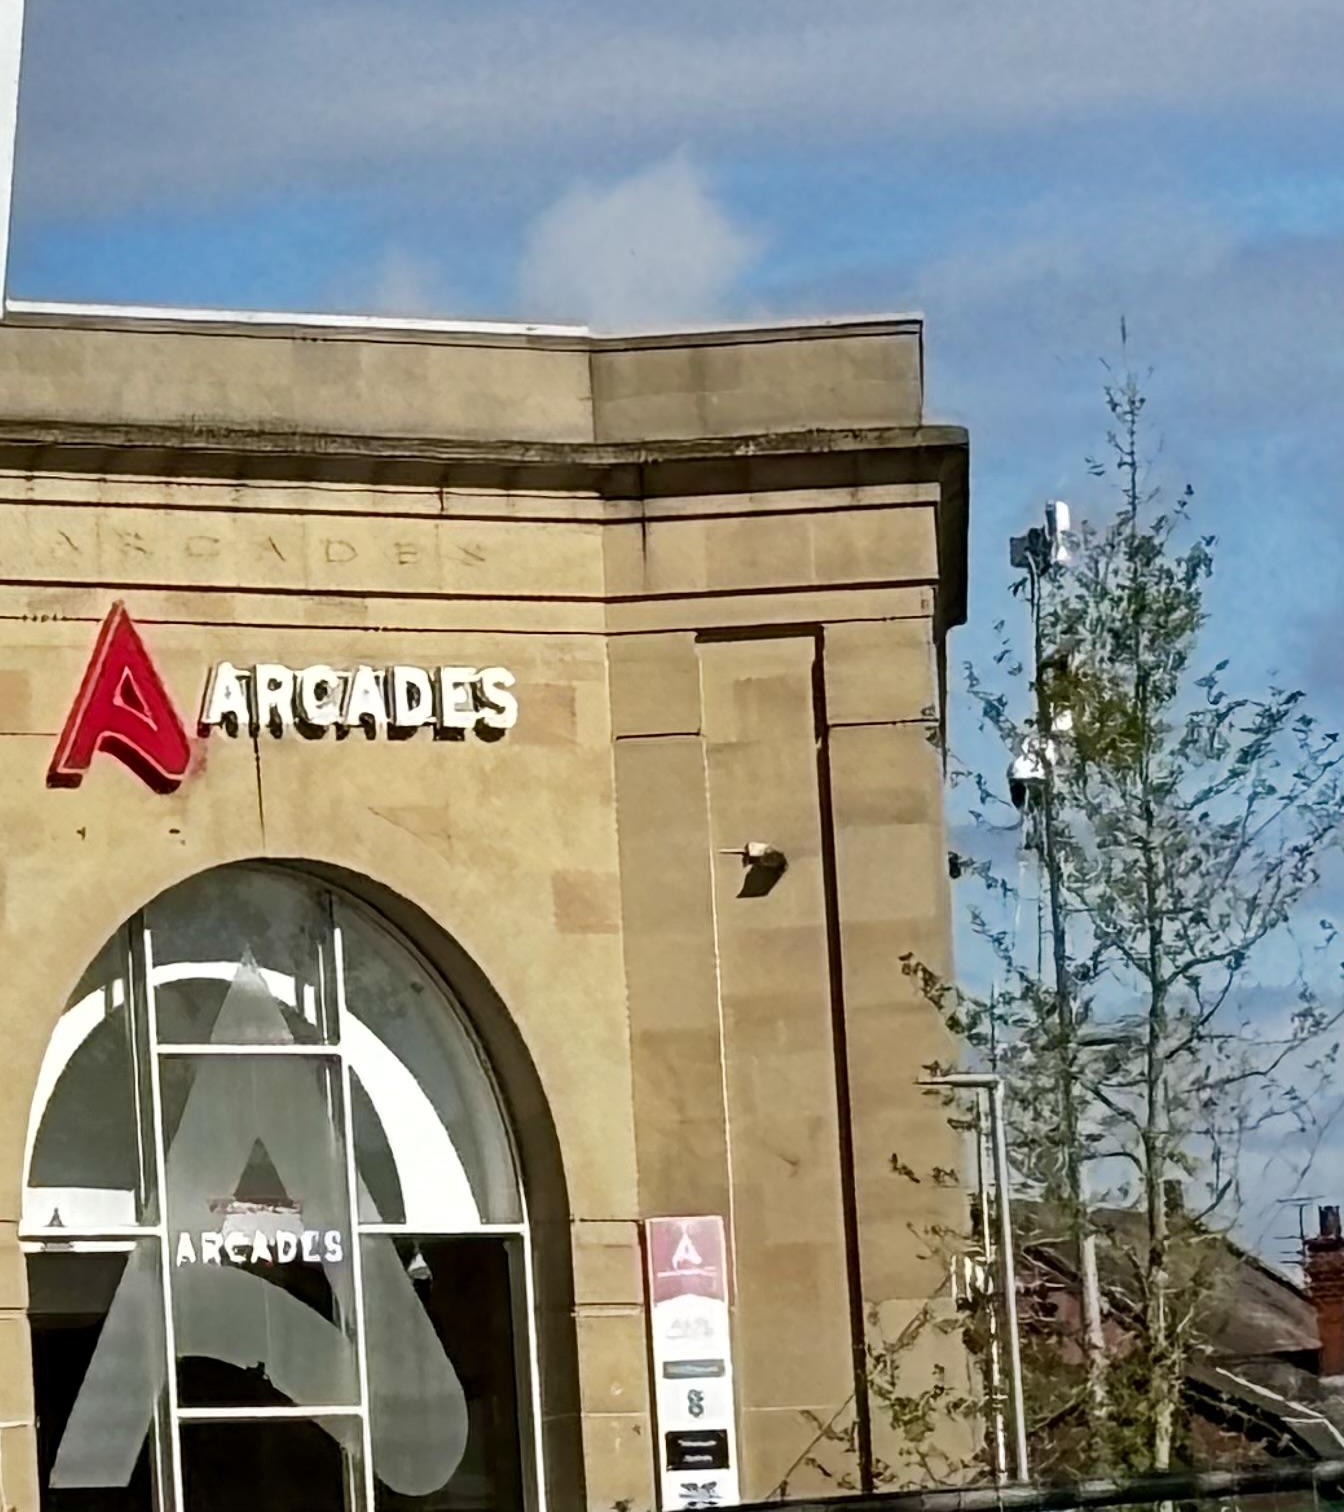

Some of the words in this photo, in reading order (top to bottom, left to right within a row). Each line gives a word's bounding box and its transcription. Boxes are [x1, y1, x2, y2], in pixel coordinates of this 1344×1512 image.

[50, 528, 488, 566] ARCADES
[201, 662, 518, 738] ARCADES
[176, 1229, 344, 1267] ARCADES
